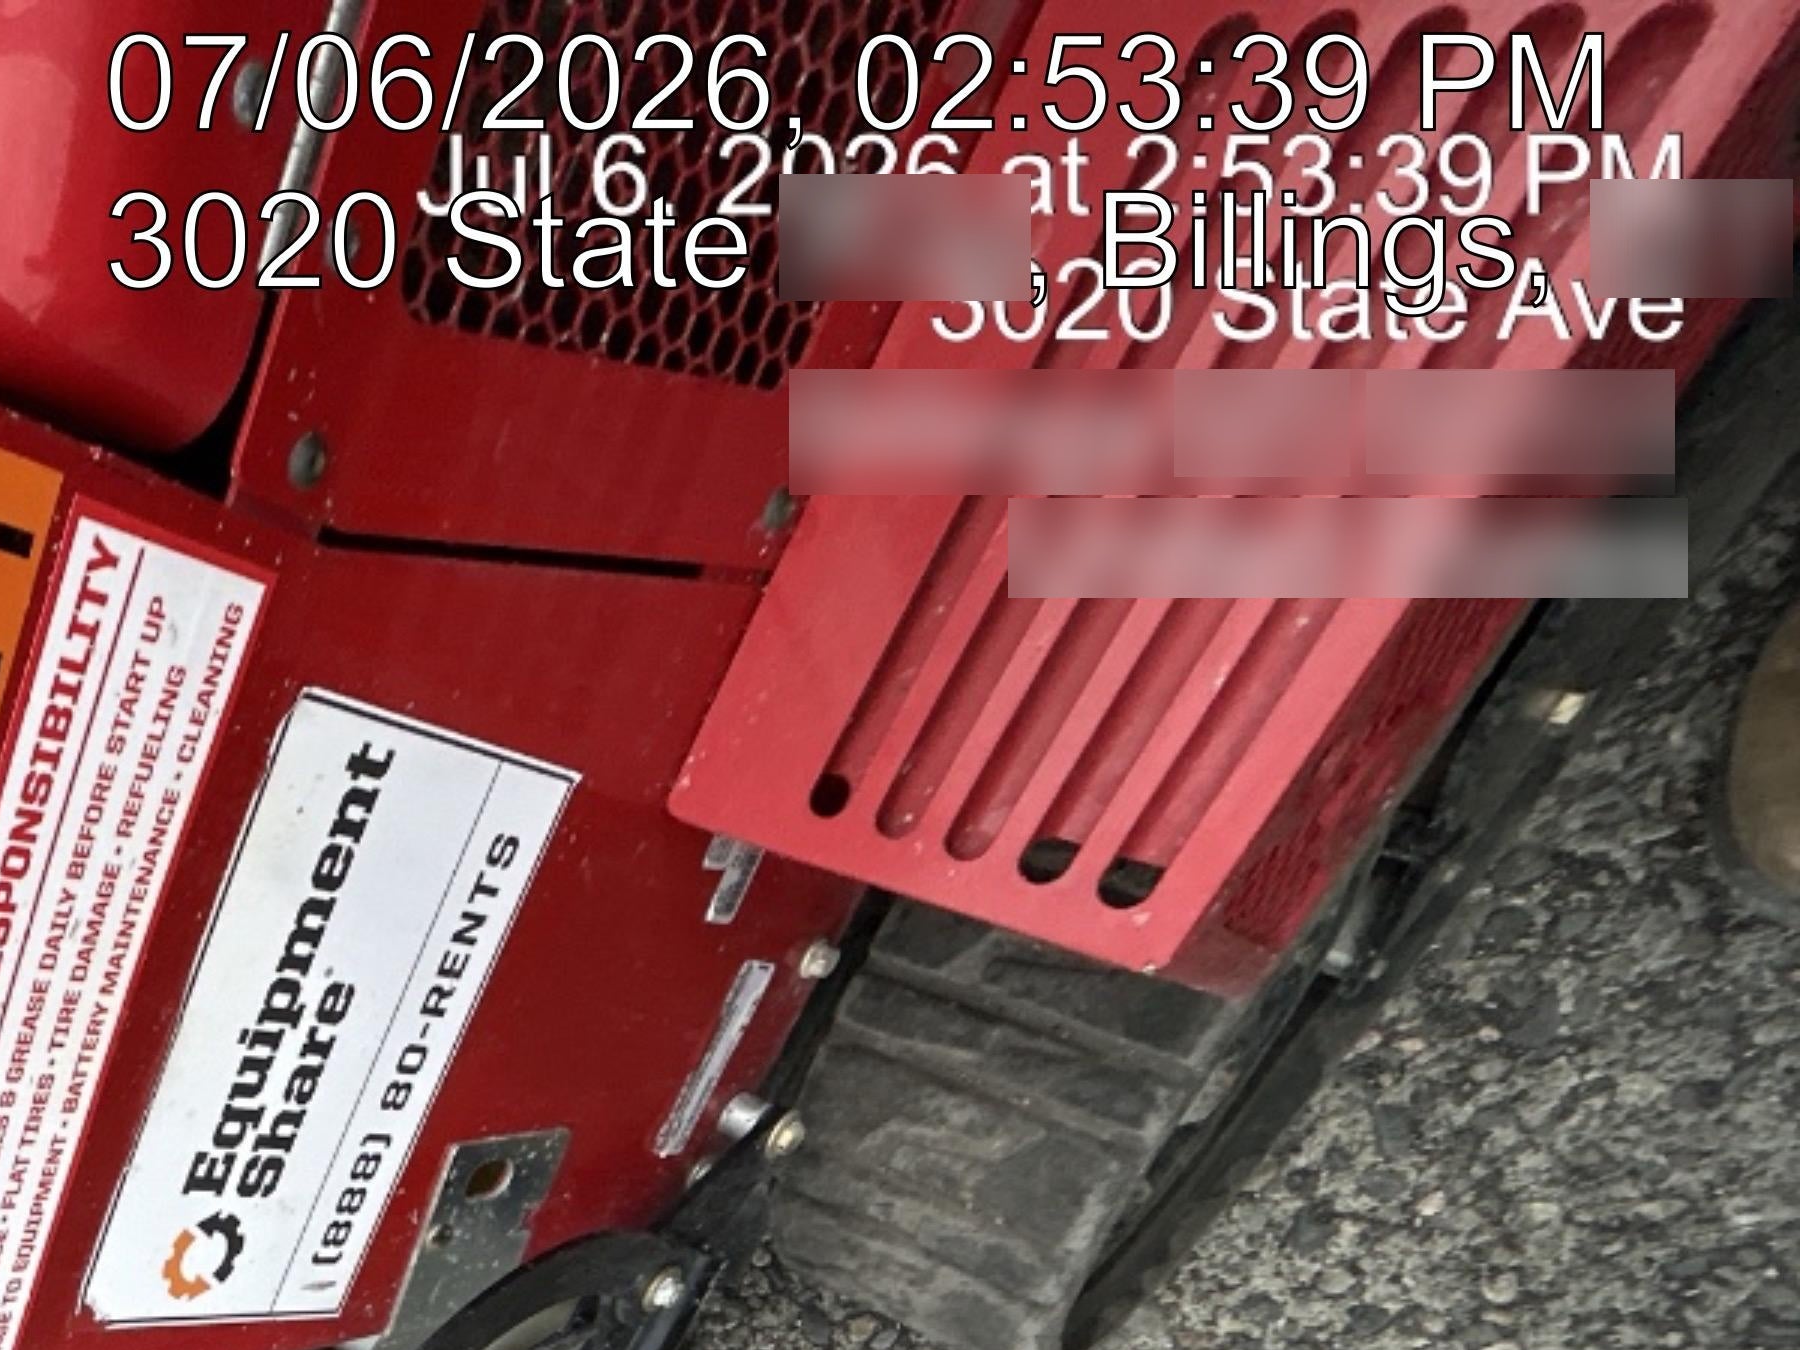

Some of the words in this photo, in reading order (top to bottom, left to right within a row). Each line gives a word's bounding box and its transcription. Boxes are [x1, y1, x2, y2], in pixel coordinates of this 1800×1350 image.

[1, 1155, 30, 1210] FLAT
[19, 1073, 55, 1148] TIRES
[48, 989, 81, 1053] TIRE
[69, 863, 121, 982] DAMAGE
[116, 665, 187, 838] REFUELING
[1, 1278, 22, 1305] TO
[12, 1133, 67, 1273] EQUIPMENT
[60, 1001, 109, 1114] BATTERY
[99, 787, 181, 996] MAINTENANCE
[176, 602, 244, 763] CLEANING
[5, 980, 50, 1083] GREASE
[38, 887, 76, 972] DAILY
[65, 764, 118, 880] BEFORE
[105, 649, 152, 755] START
[140, 596, 167, 643] UP
[181, 740, 396, 1197] Equipment
[311, 1131, 391, 1266] (888)
[379, 832, 521, 1112] 80-RENTS
[235, 978, 355, 1199] Share
